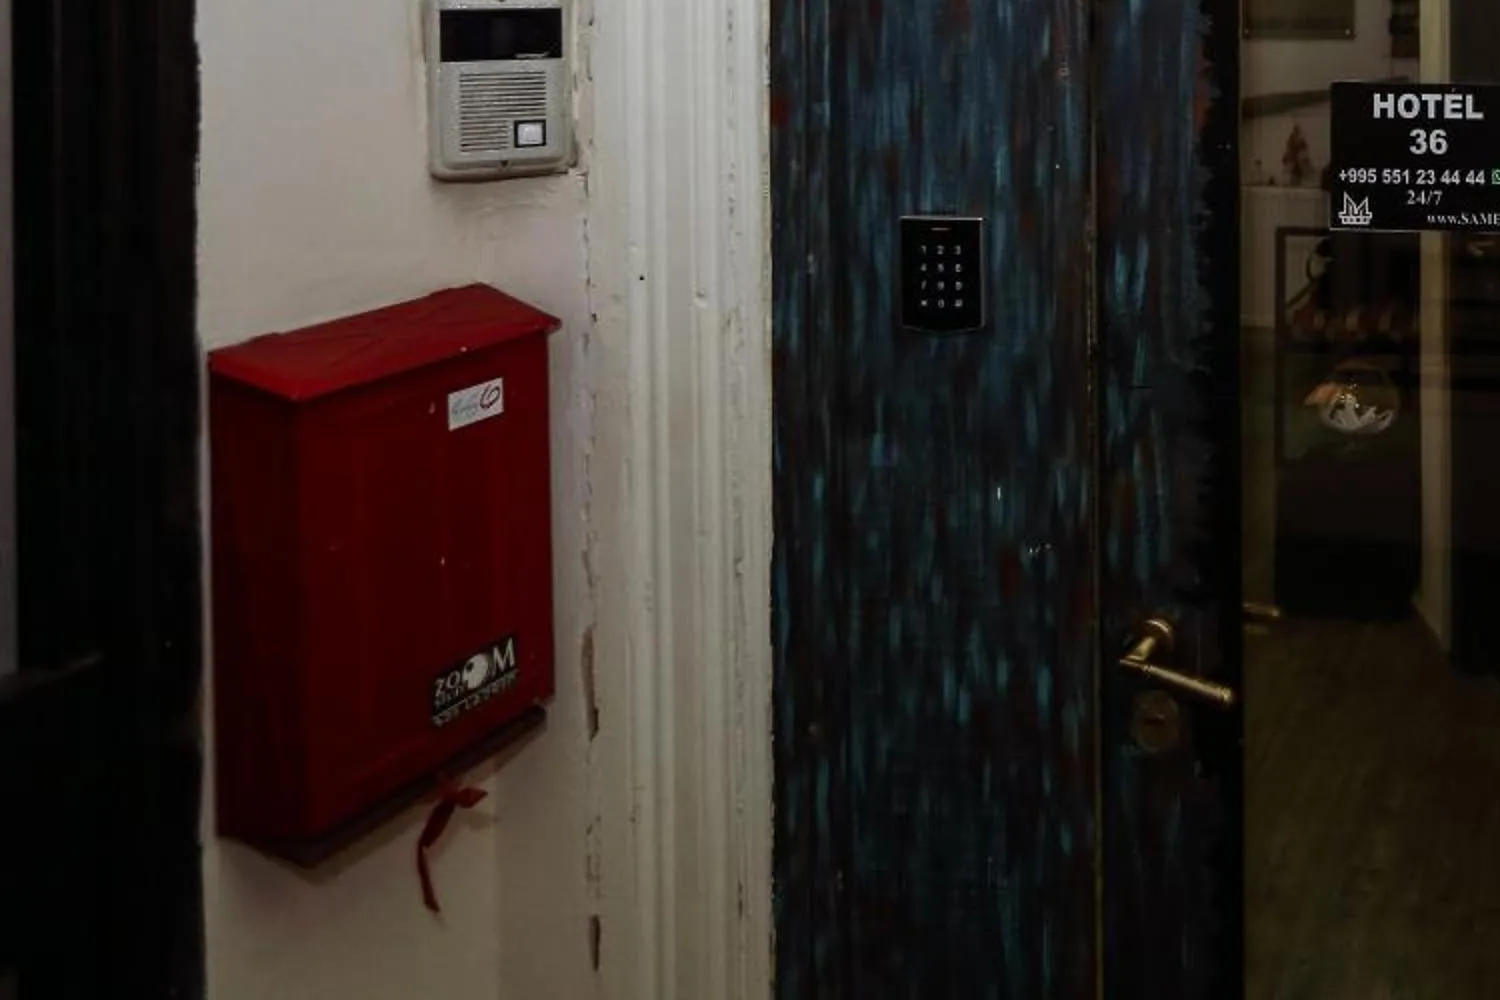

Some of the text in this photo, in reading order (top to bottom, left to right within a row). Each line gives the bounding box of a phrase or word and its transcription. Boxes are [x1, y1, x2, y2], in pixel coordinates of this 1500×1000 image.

[1372, 92, 1485, 120] HOTEL
[1408, 128, 1449, 155] 36
[1338, 167, 1486, 186] +995 551 23 44 44
[1406, 189, 1443, 206] 24/7
